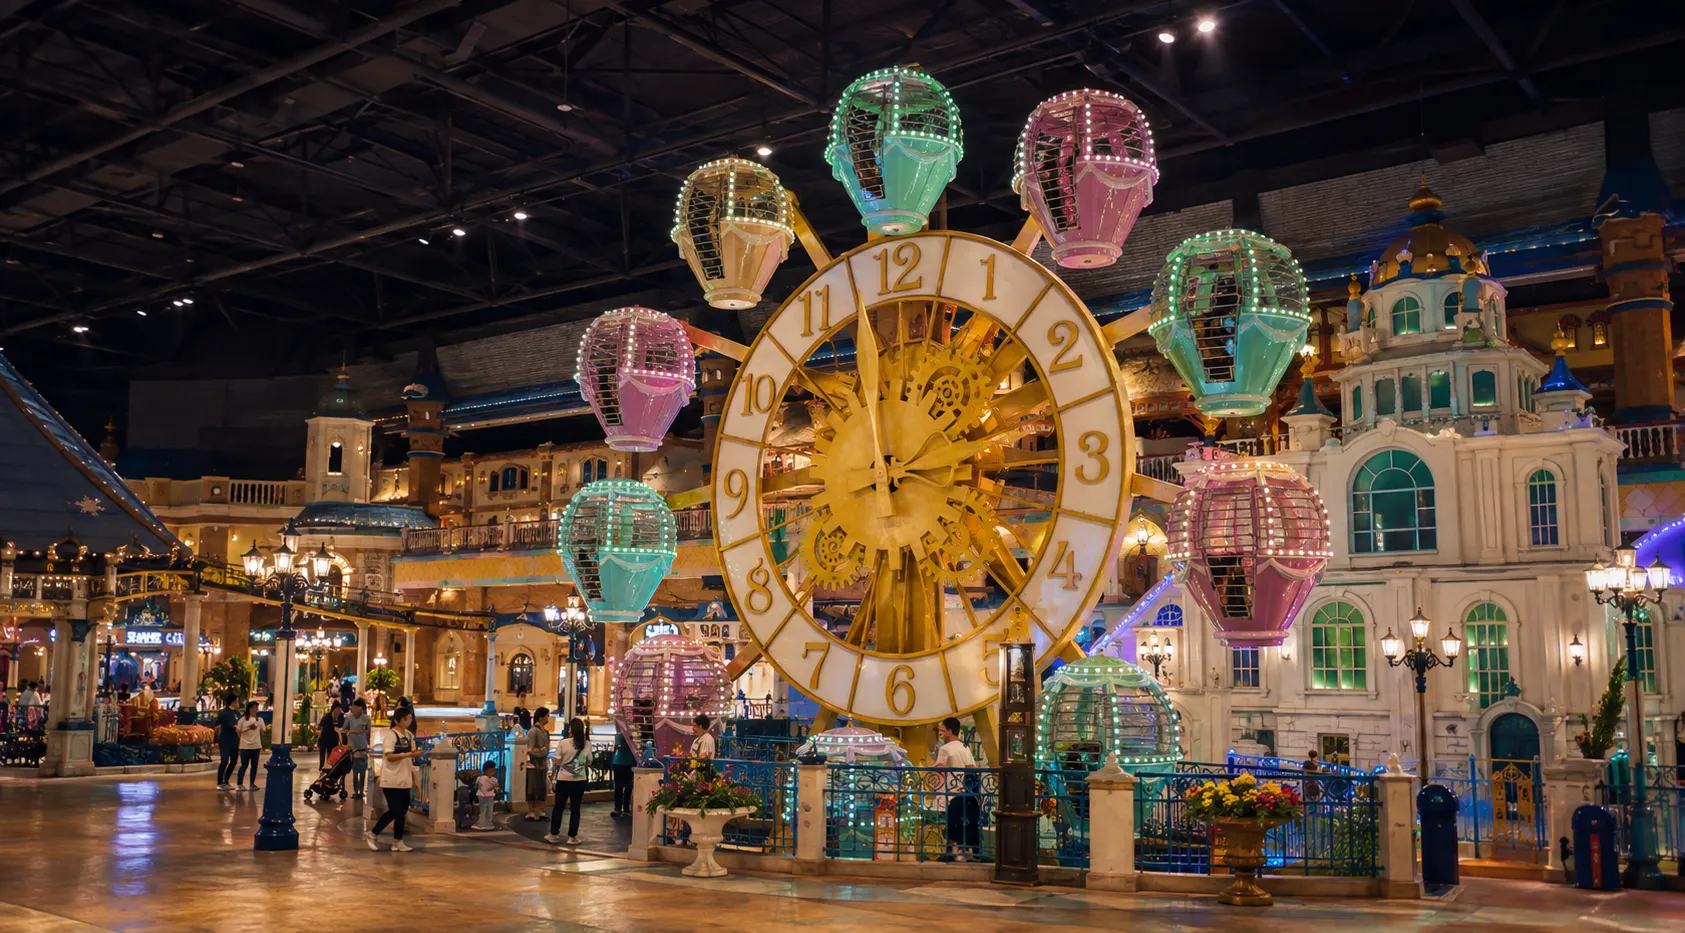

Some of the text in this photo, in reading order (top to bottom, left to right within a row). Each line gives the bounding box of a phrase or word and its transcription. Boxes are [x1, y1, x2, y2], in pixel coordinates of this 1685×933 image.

[874, 243, 922, 296] 12
[979, 253, 998, 301] 1
[797, 285, 832, 338] 11
[1046, 320, 1083, 373] 2
[740, 373, 776, 416] 10
[1075, 431, 1110, 485] 3
[723, 469, 749, 520] 9
[744, 558, 773, 614] 8
[1047, 541, 1082, 590] 4
[801, 642, 830, 689] 7
[980, 628, 1009, 686] 5
[885, 665, 916, 715] 6
